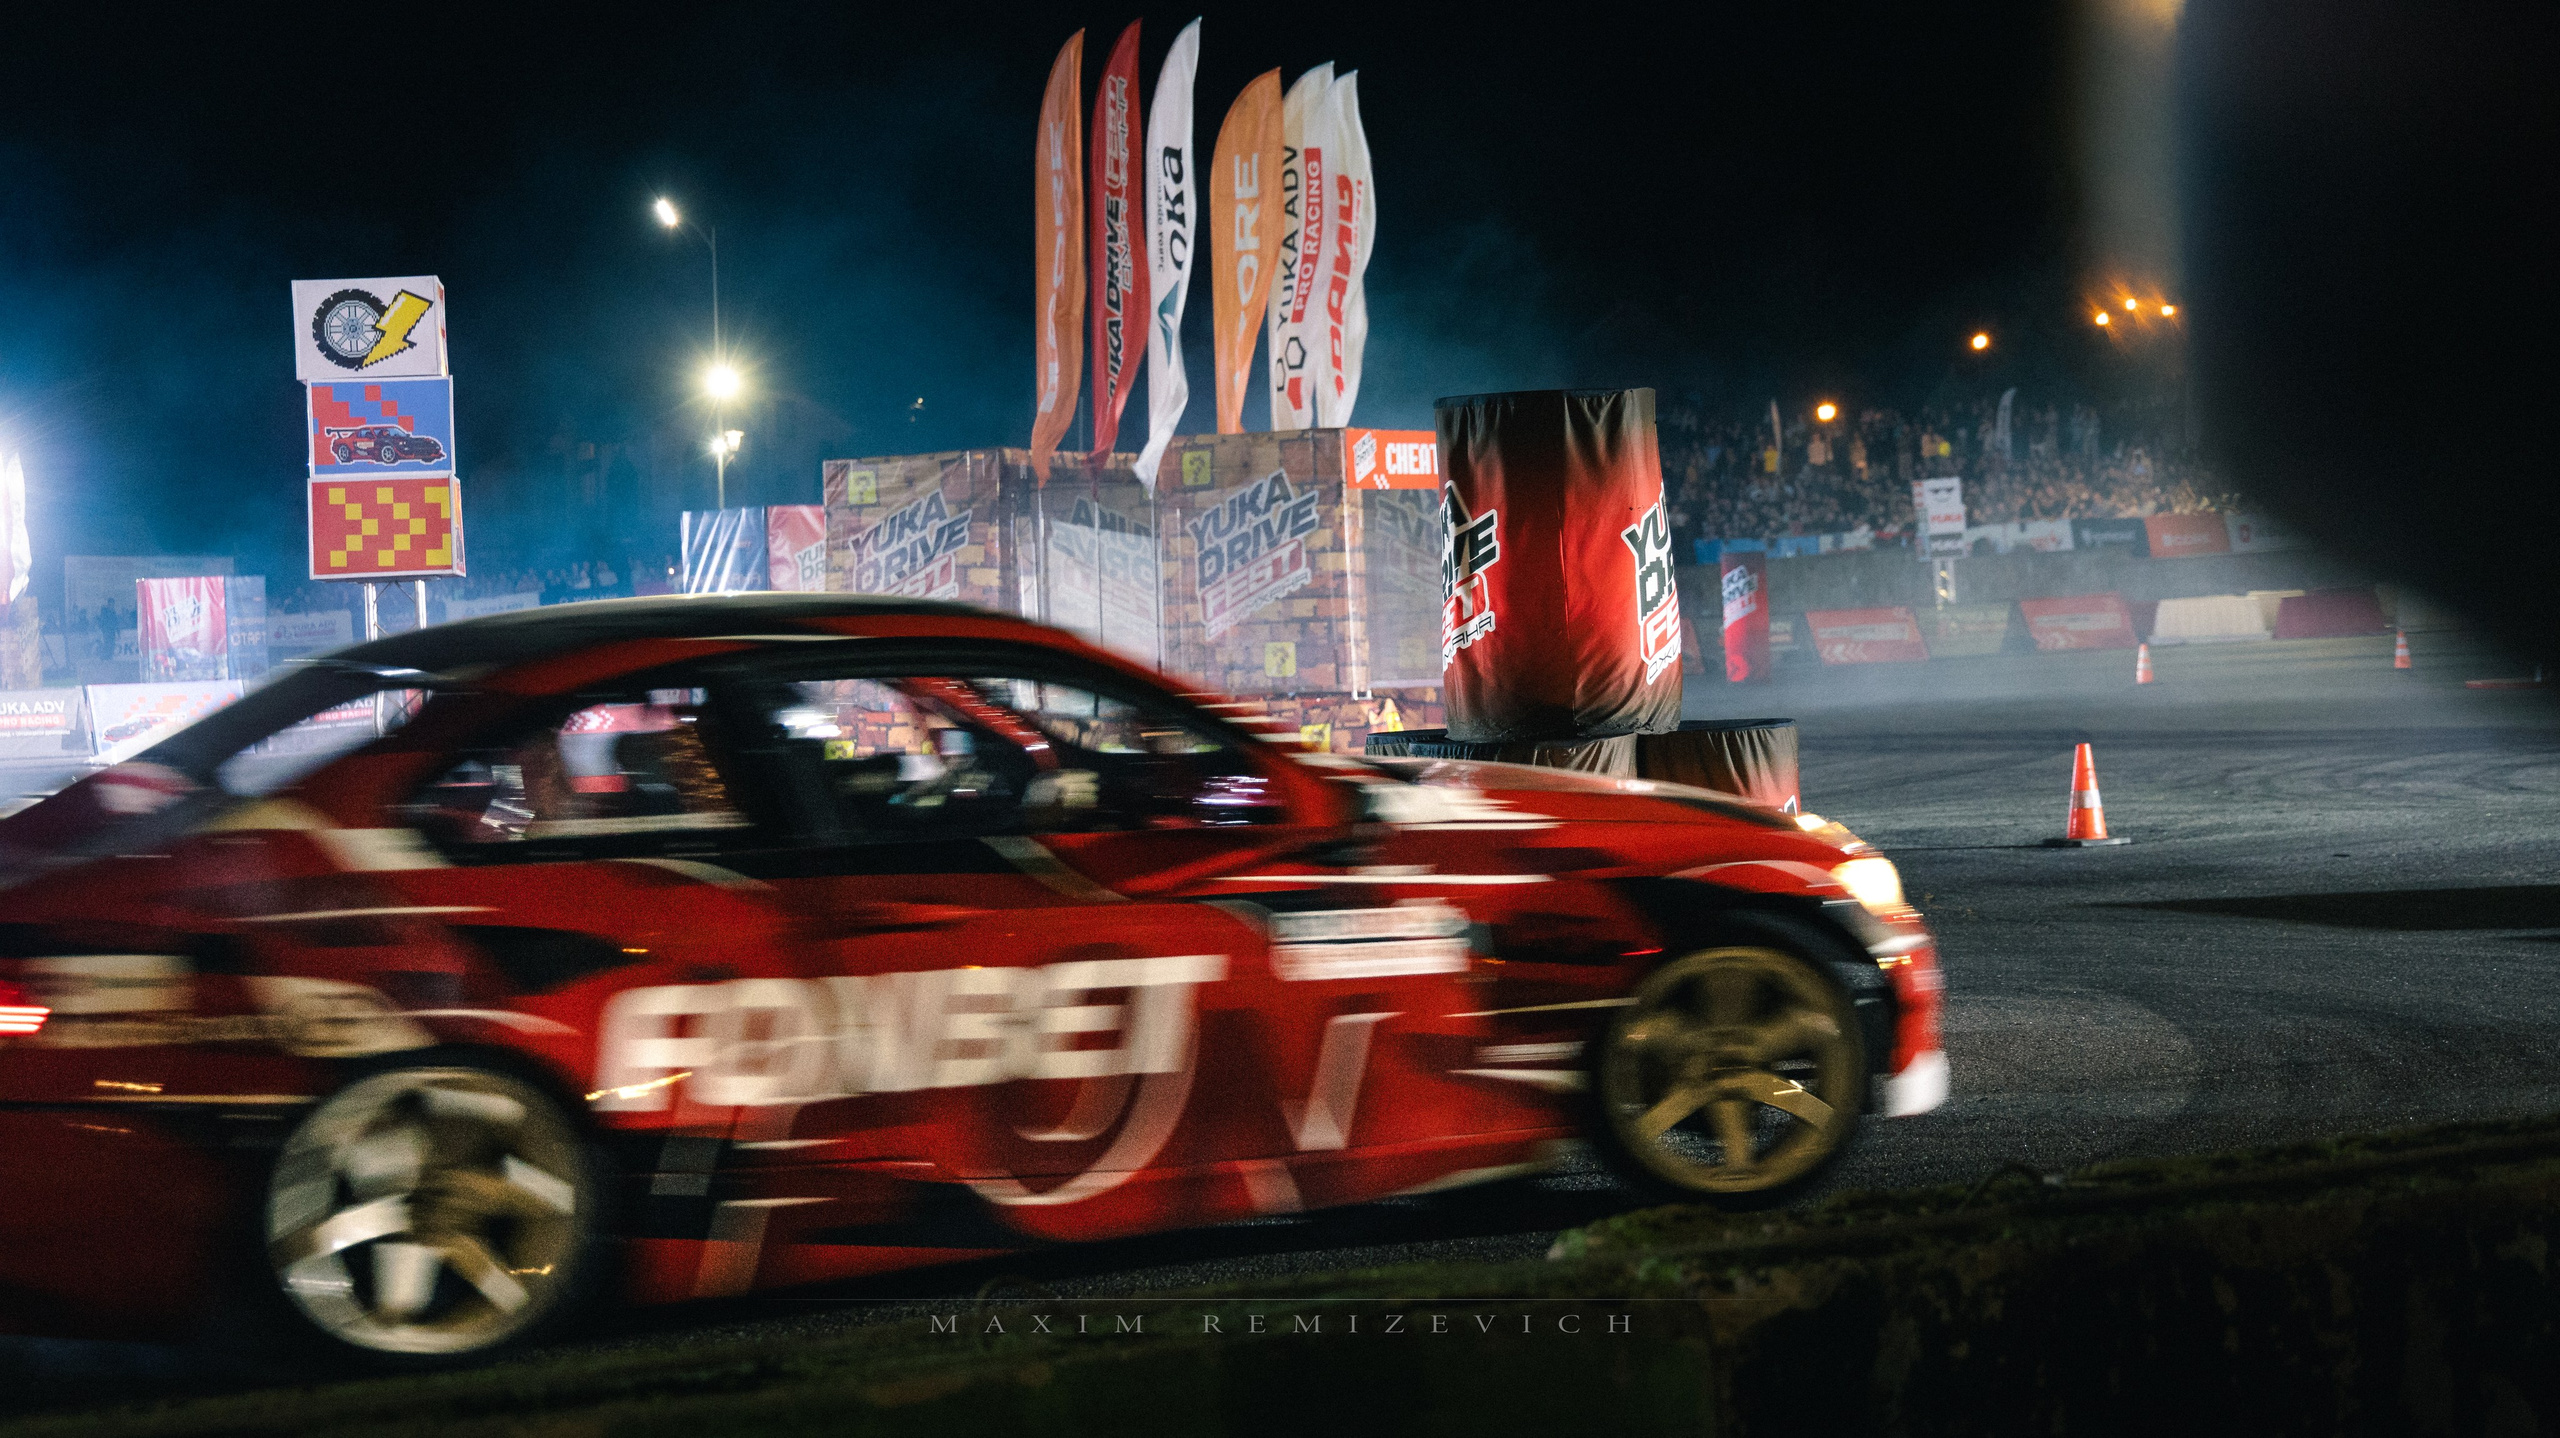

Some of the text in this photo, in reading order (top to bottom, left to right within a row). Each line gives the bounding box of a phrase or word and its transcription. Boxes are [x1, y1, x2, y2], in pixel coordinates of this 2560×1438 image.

[1105, 196, 1122, 314] DRIVE
[1277, 145, 1299, 332] YUKA ADV
[1295, 160, 1321, 311] PRO RACING
[852, 491, 948, 566] YUKA
[1193, 472, 1292, 551] YUKA
[1199, 493, 1317, 588] DRIVE
[856, 512, 970, 593] DRIVE
[1203, 541, 1301, 622] FEST
[20, 715, 60, 726] RACING
[33, 699, 65, 714] ADV
